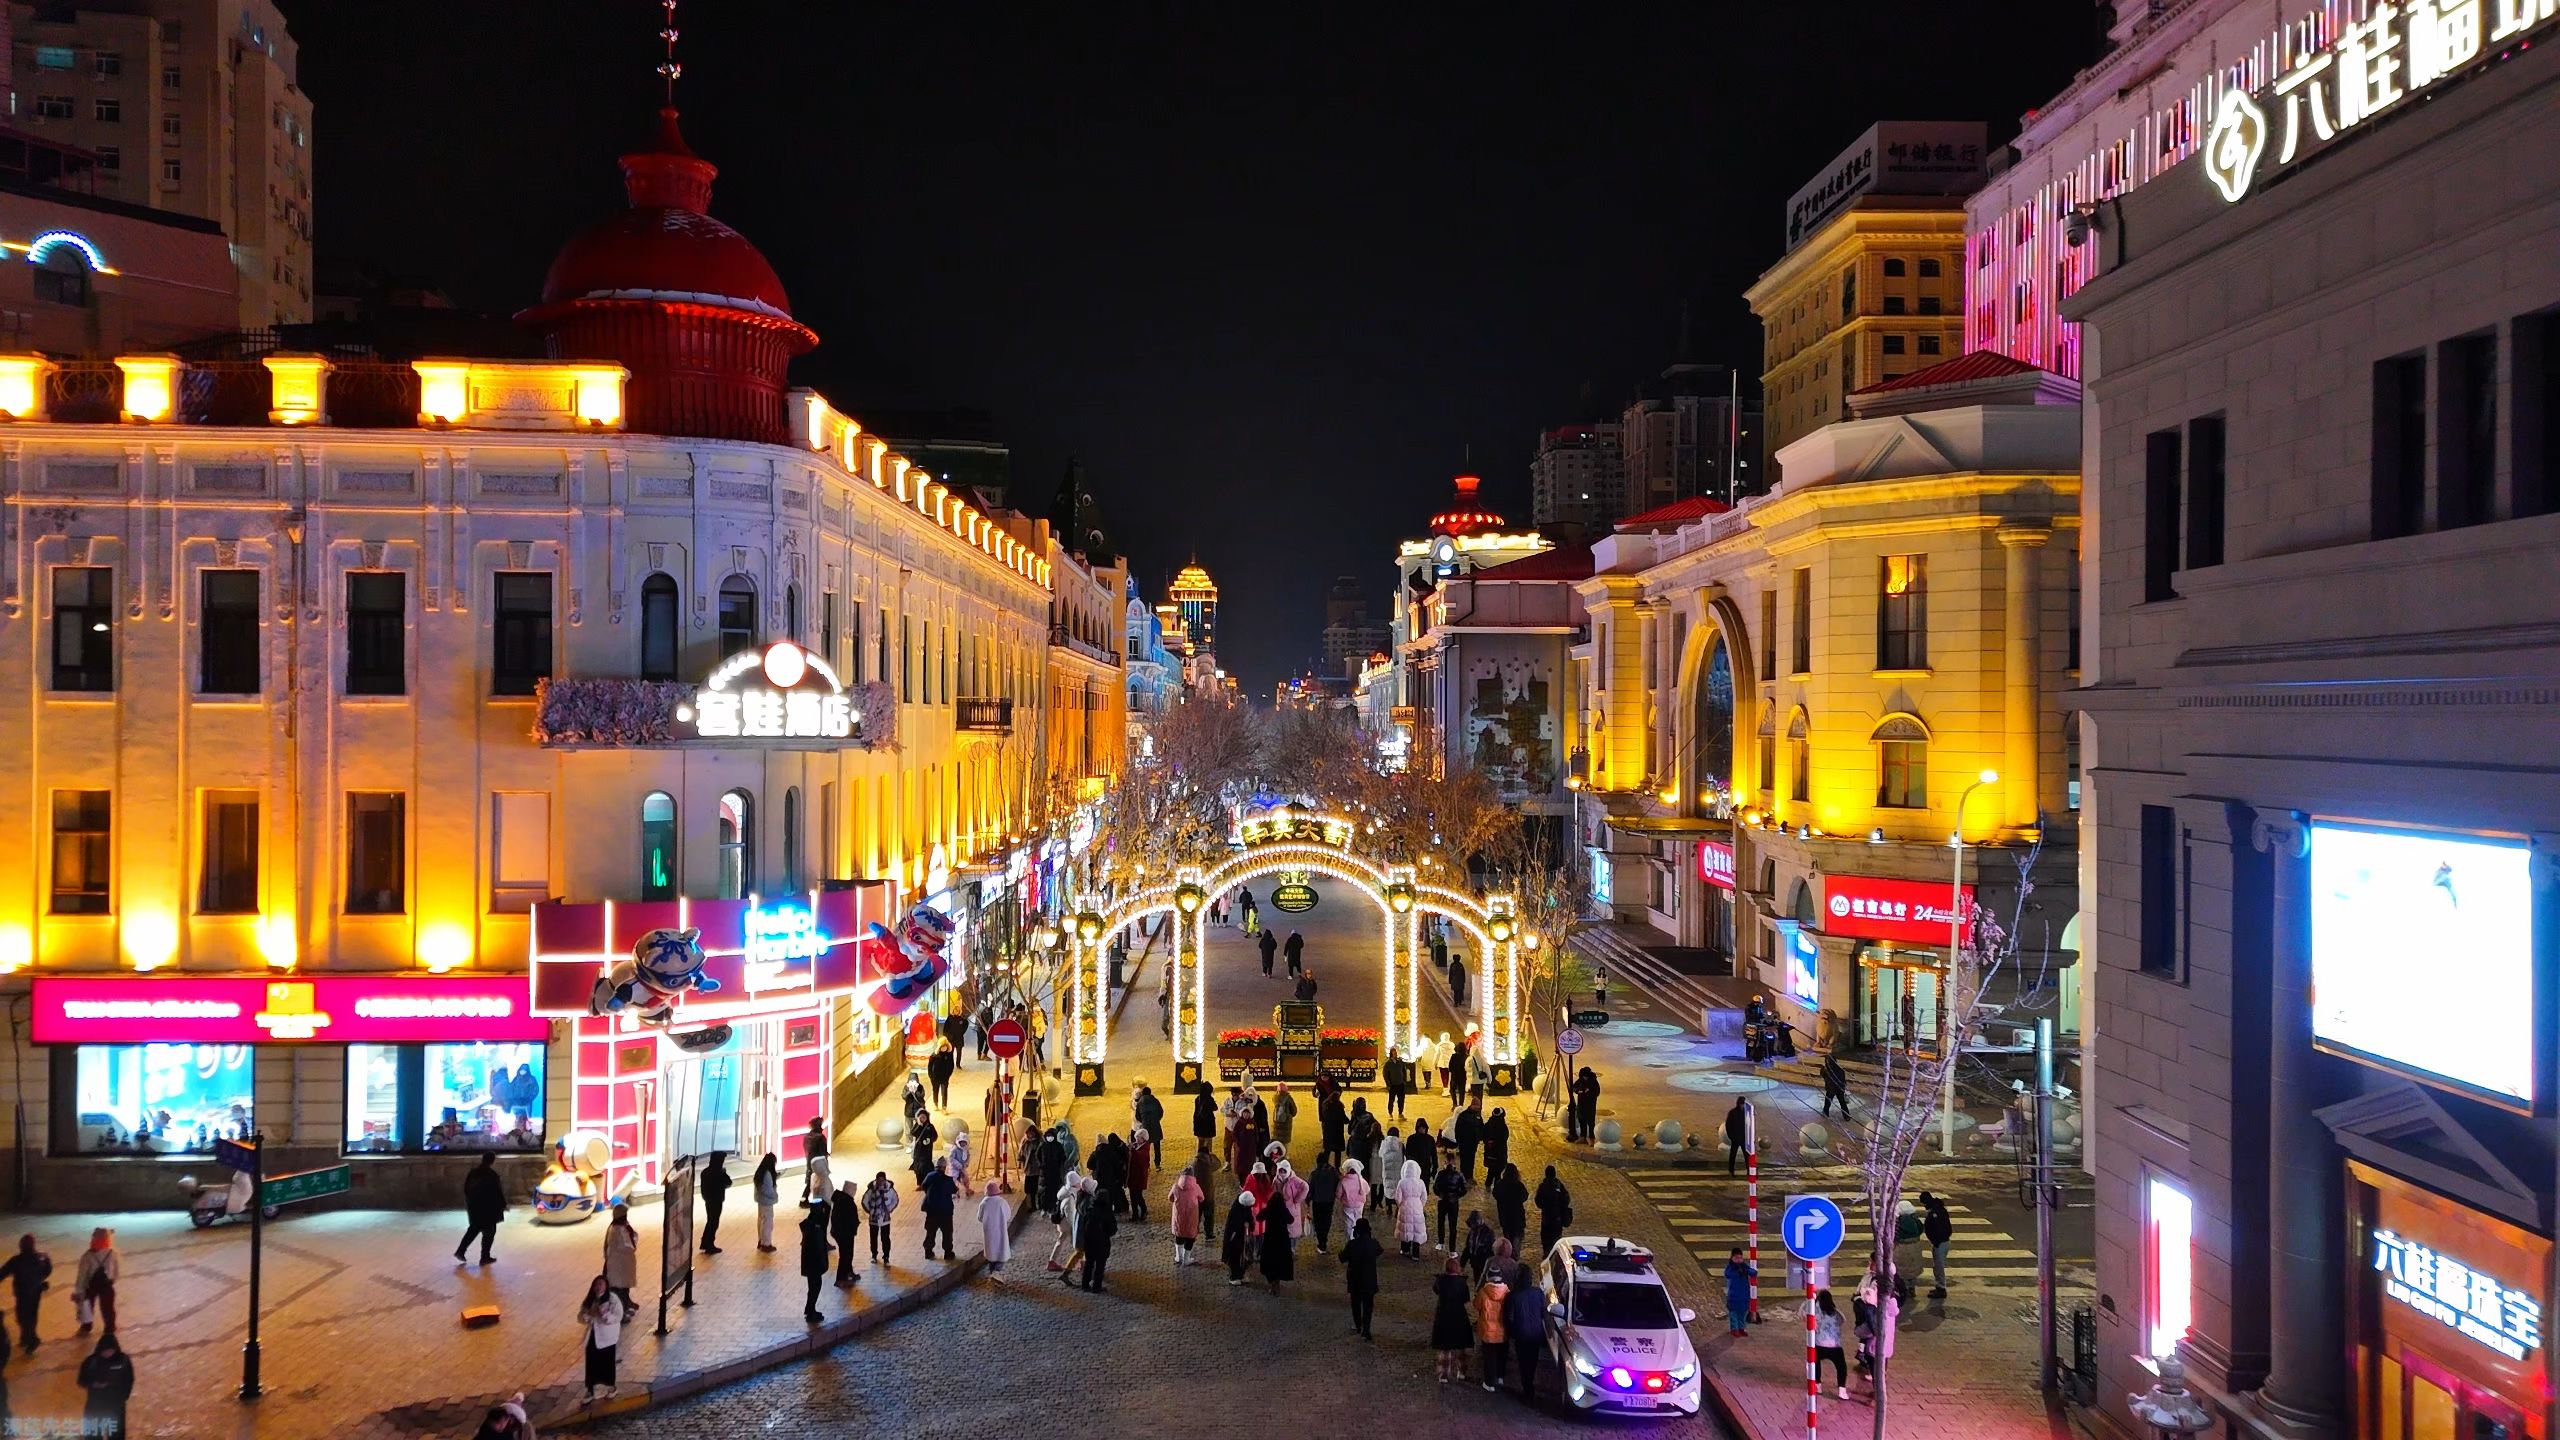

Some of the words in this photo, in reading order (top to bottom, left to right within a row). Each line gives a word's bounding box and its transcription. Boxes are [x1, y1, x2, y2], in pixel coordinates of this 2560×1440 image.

[1244, 820, 1347, 847] 中央大街
[745, 907, 813, 936] Hello
[1914, 905, 1933, 921] 24
[745, 930, 829, 962] Harbin
[272, 1171, 340, 1193] 中央大街
[1609, 1336, 1655, 1347] 警察
